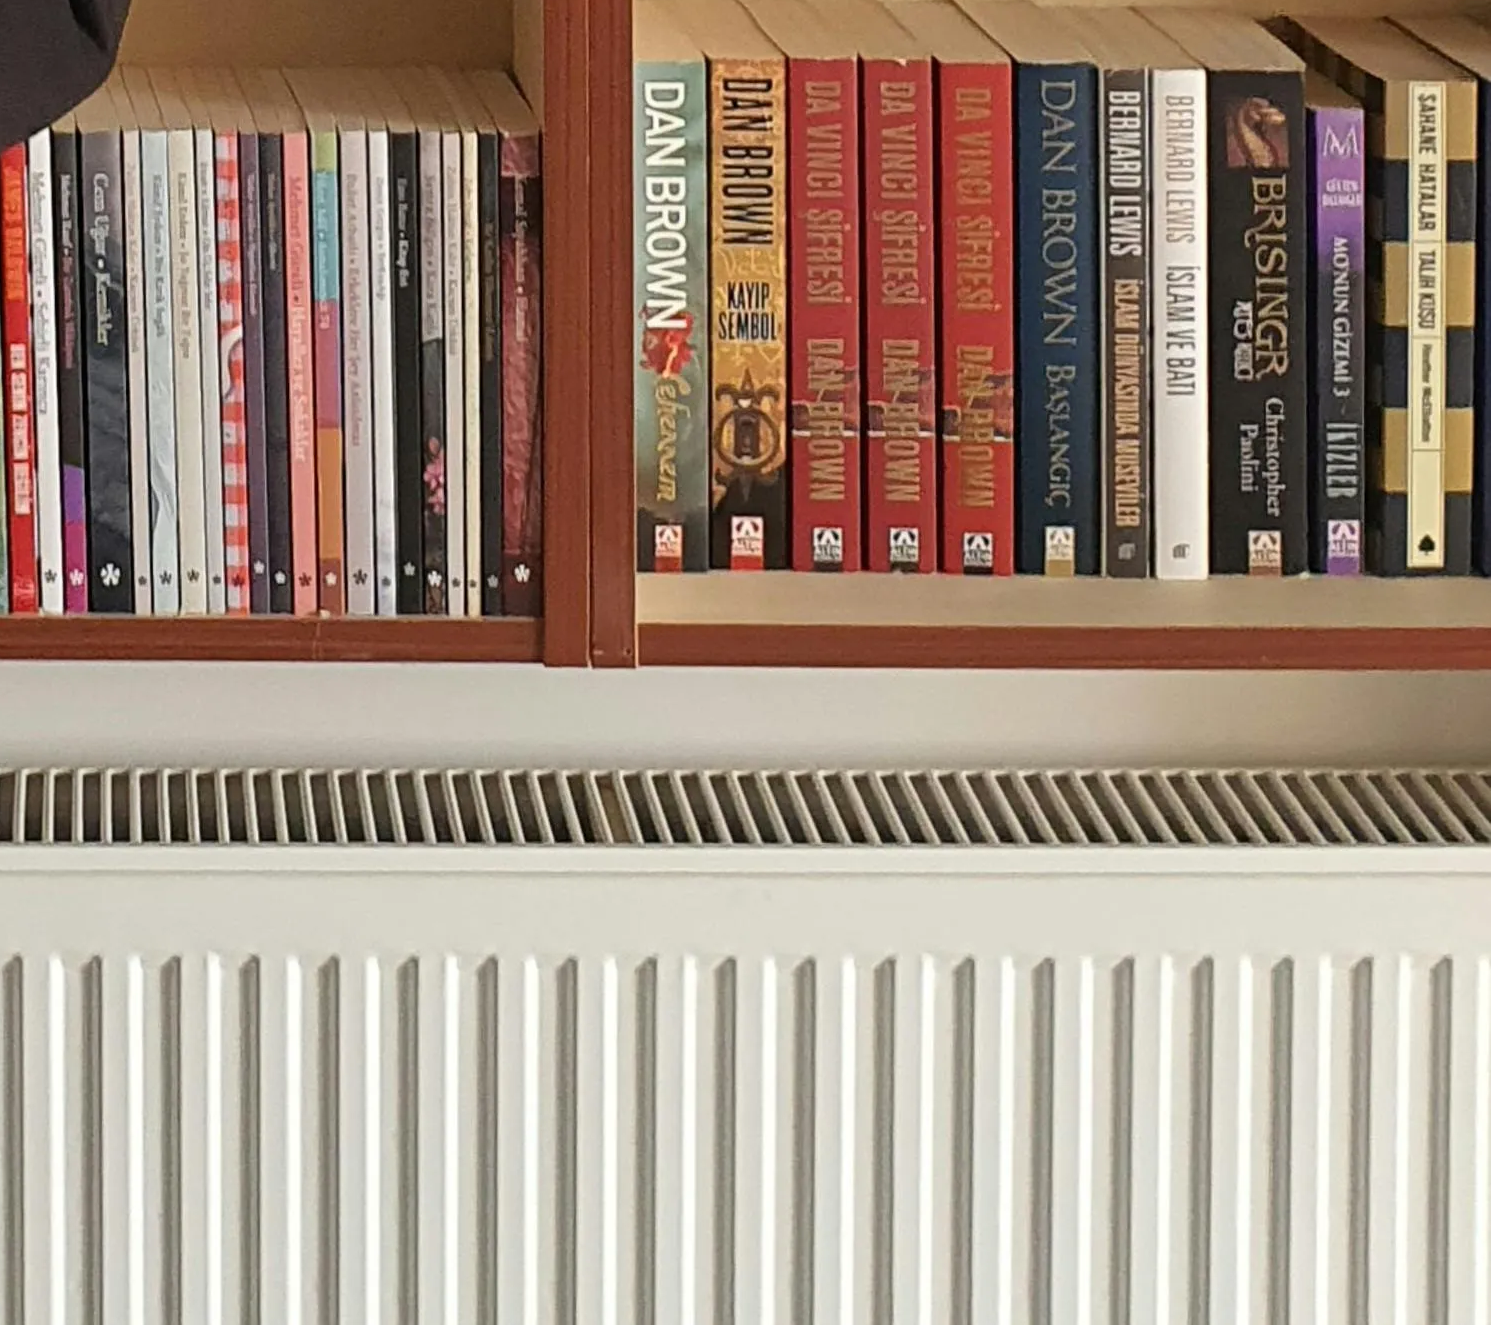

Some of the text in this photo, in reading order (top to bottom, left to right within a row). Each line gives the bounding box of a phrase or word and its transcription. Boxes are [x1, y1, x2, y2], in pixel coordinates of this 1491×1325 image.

[721, 78, 774, 246] DAN BROWN
[954, 87, 990, 123] DA
[955, 131, 993, 205] VINCI
[1106, 90, 1142, 257] BERNARD LEWIS
[1165, 94, 1195, 243] BERNARD LEWIS
[643, 80, 688, 329] DAN BROWN
[796, 81, 851, 304] DA VINCI ŞİFRESİ
[872, 81, 927, 304] DA VINCI ŞİFRESİ
[1039, 78, 1078, 345] DAN BROWN
[717, 311, 778, 341] SEMBOL
[725, 281, 771, 310] KAYIP
[1165, 265, 1201, 397] İSLAM VE BATI
[1244, 174, 1289, 381] BRISINGR
[1332, 315, 1353, 384] GİZEMİ
[807, 338, 846, 501] DAN BROWN
[881, 338, 920, 501] DAN BROWN
[955, 345, 997, 507] DAN BROWN
[1112, 278, 1145, 527] İSLAM DÜNYASINDA MUSEVİLER
[1238, 422, 1260, 493] Paolini
[1262, 397, 1286, 517] Christopher
[1332, 385, 1350, 398] 3
